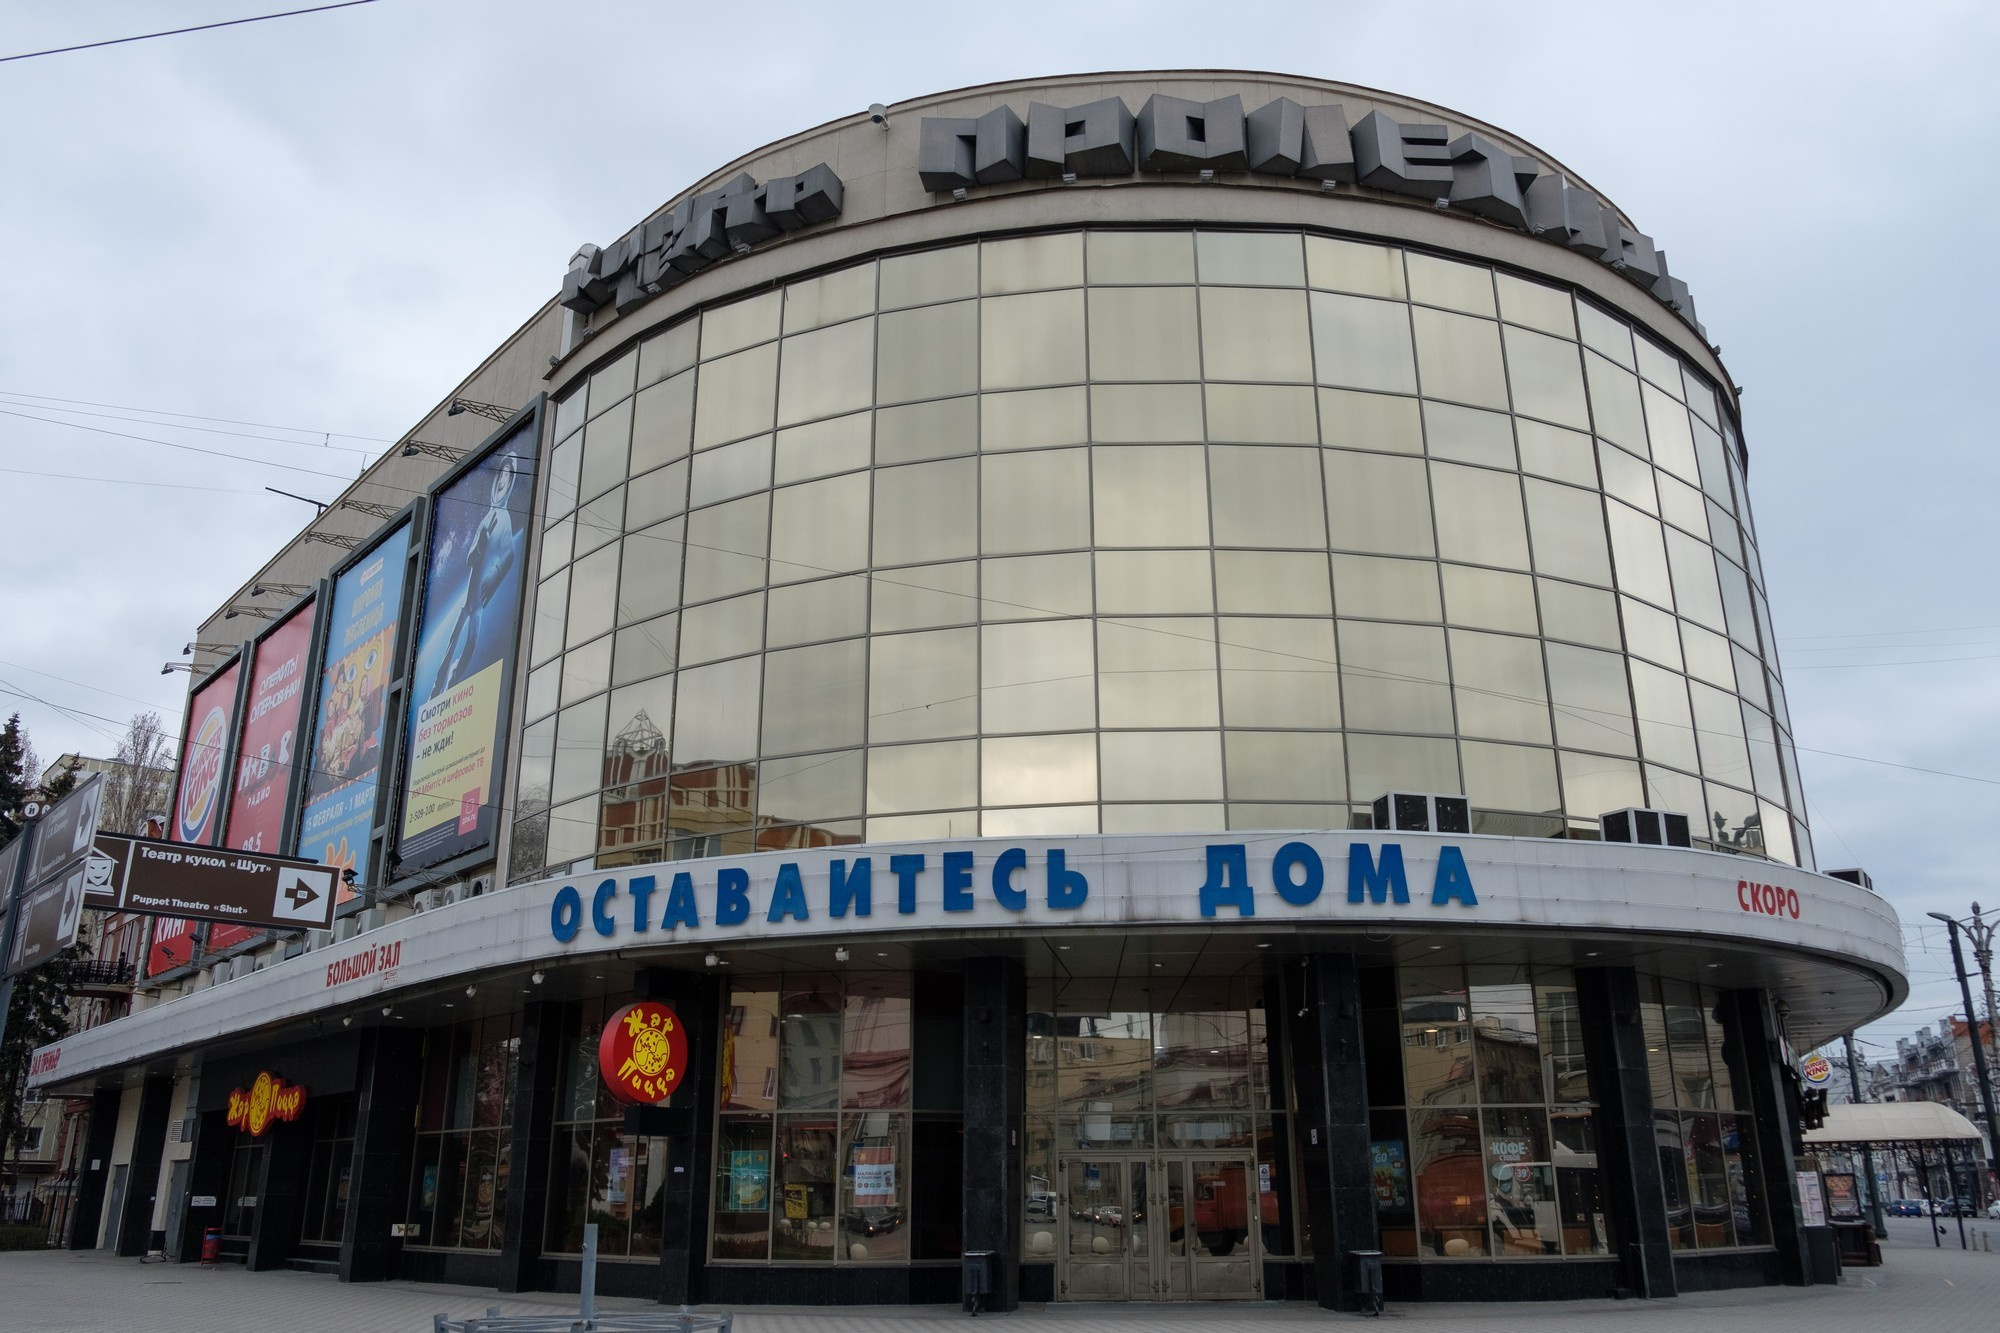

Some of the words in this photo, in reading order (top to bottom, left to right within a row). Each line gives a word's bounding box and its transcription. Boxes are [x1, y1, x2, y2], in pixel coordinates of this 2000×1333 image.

[919, 93, 1709, 345] ПРОЛЕТАР
[420, 698, 451, 723] Смотри
[452, 685, 475, 706] кино
[418, 724, 432, 743] без
[433, 704, 473, 736] тормозов
[188, 726, 223, 789] BURGER
[421, 741, 432, 759] не
[433, 729, 455, 755] жди!
[183, 748, 220, 825] KING
[447, 763, 476, 786] цифровое
[247, 785, 271, 809] РАДИО
[313, 801, 344, 828] ФЕВРАЛЯ
[409, 803, 436, 824] 2-509-100
[141, 846, 182, 863] Театр
[185, 854, 227, 869] кукол
[230, 859, 272, 873] «Шут»
[1199, 842, 1478, 918] ДОМА
[132, 893, 170, 908] Puppet
[172, 898, 210, 911] Theatre
[213, 903, 248, 914] «Shut»
[1737, 880, 1800, 920] СКОРО
[326, 943, 377, 987] БОЛЬШОЙ
[378, 940, 401, 972] ЗАЛ
[623, 1008, 674, 1038] Жар
[617, 1056, 675, 1099] Пицца
[1804, 1059, 1827, 1071] BURGER
[1806, 1065, 1829, 1078] KING
[228, 1092, 250, 1127] Жар
[269, 1084, 299, 1115] Пицца
[1375, 1152, 1387, 1163] GO
[1492, 1142, 1526, 1155] КОФЕ
